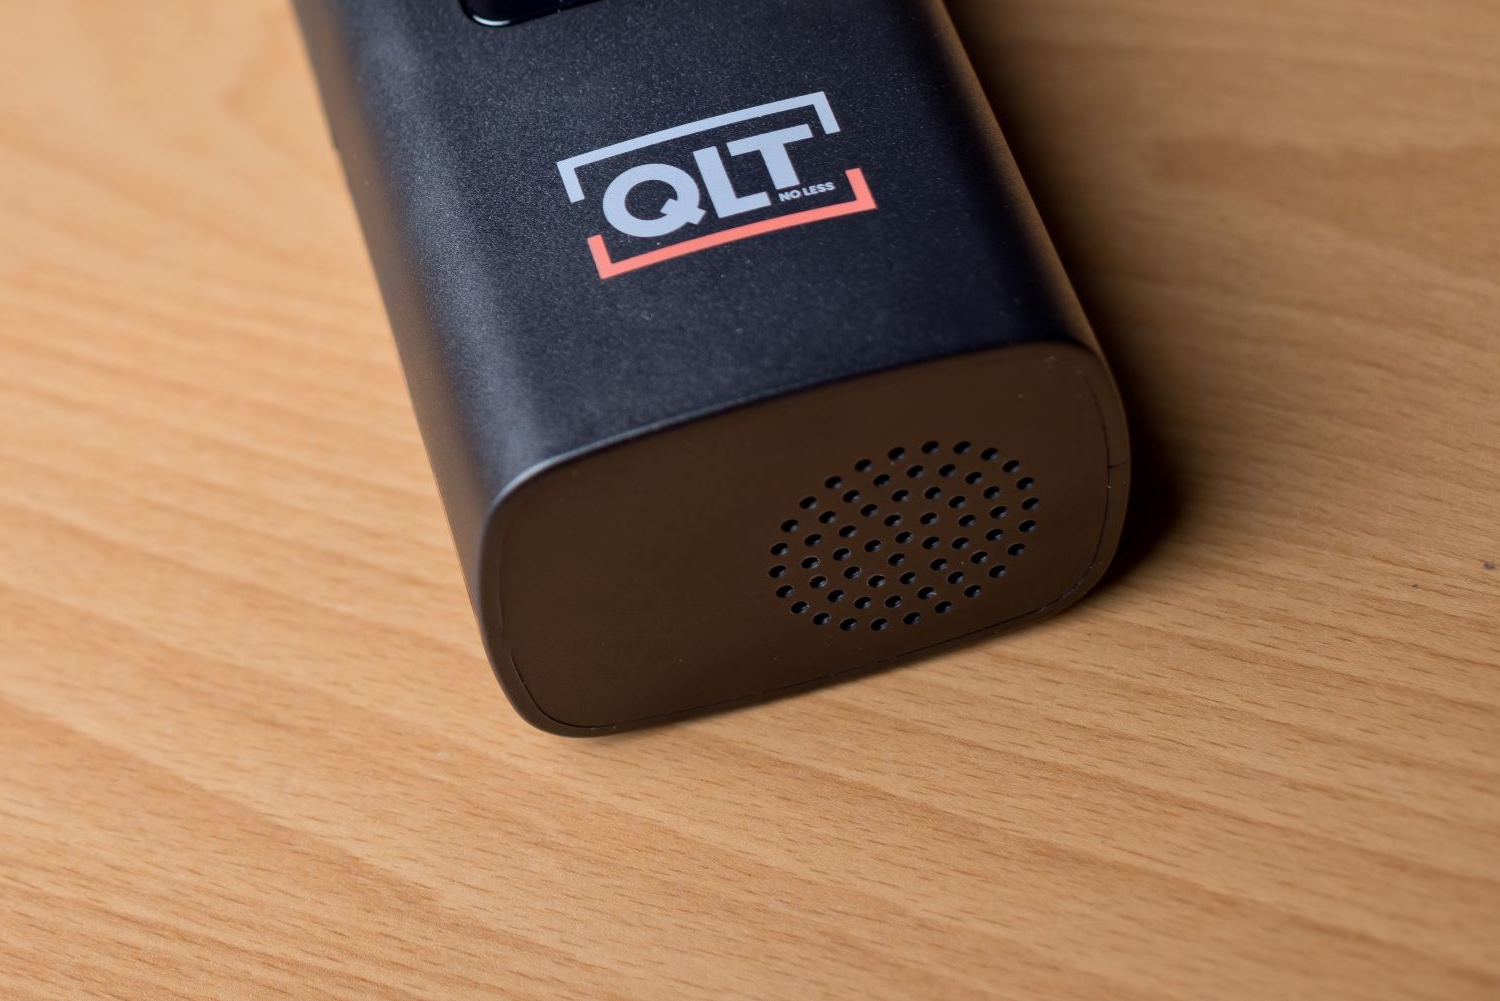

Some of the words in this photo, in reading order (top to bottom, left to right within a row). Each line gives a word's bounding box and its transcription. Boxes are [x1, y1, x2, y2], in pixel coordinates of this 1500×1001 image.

[602, 123, 814, 238] QLT
[778, 189, 802, 202] NO
[802, 181, 836, 196] LESS
